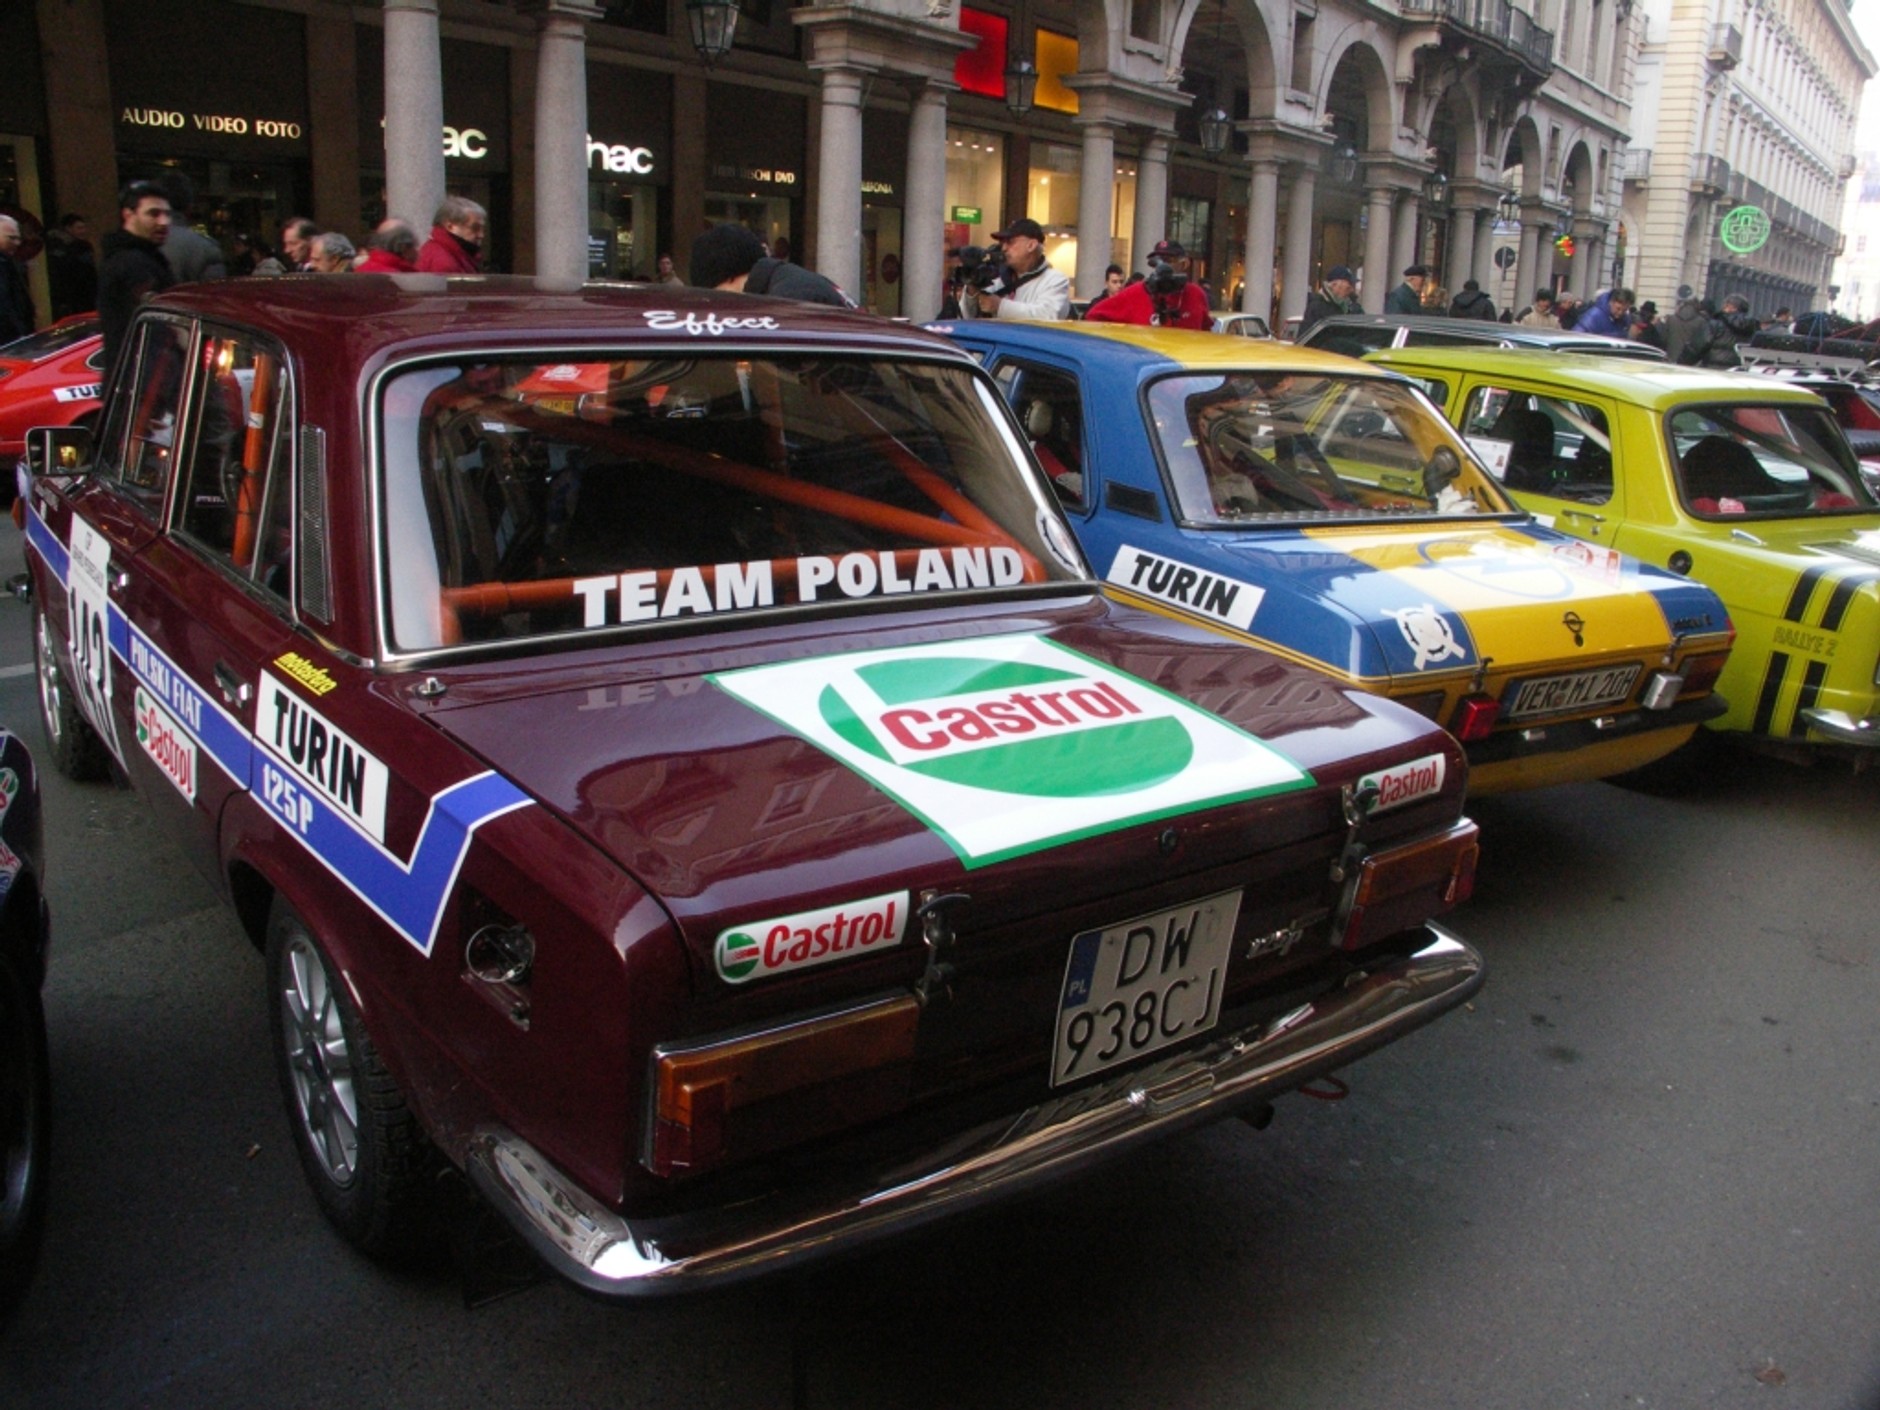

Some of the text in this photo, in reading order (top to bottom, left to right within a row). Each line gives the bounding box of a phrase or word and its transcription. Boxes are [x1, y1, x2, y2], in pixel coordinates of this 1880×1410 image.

[122, 107, 301, 139] AUDIO VIDEO FOTO
[774, 171, 796, 185] DVD
[642, 310, 780, 336] Effect
[573, 547, 1025, 629] TEAM POLAND
[1130, 553, 1241, 617] TURIN
[1773, 626, 1839, 657] RALLYE 2
[130, 635, 203, 732] POLSKI FIAT
[880, 681, 1143, 751] Castrol
[1516, 681, 1560, 712] VER
[148, 707, 193, 794] Castrol
[273, 688, 367, 819] TURIN
[1379, 759, 1437, 805] Castrol
[263, 763, 314, 835] 125P
[763, 901, 896, 968] Castrol
[1116, 910, 1200, 989] DW
[1064, 966, 1218, 1076] 938CJ
[1067, 978, 1087, 998] PL
